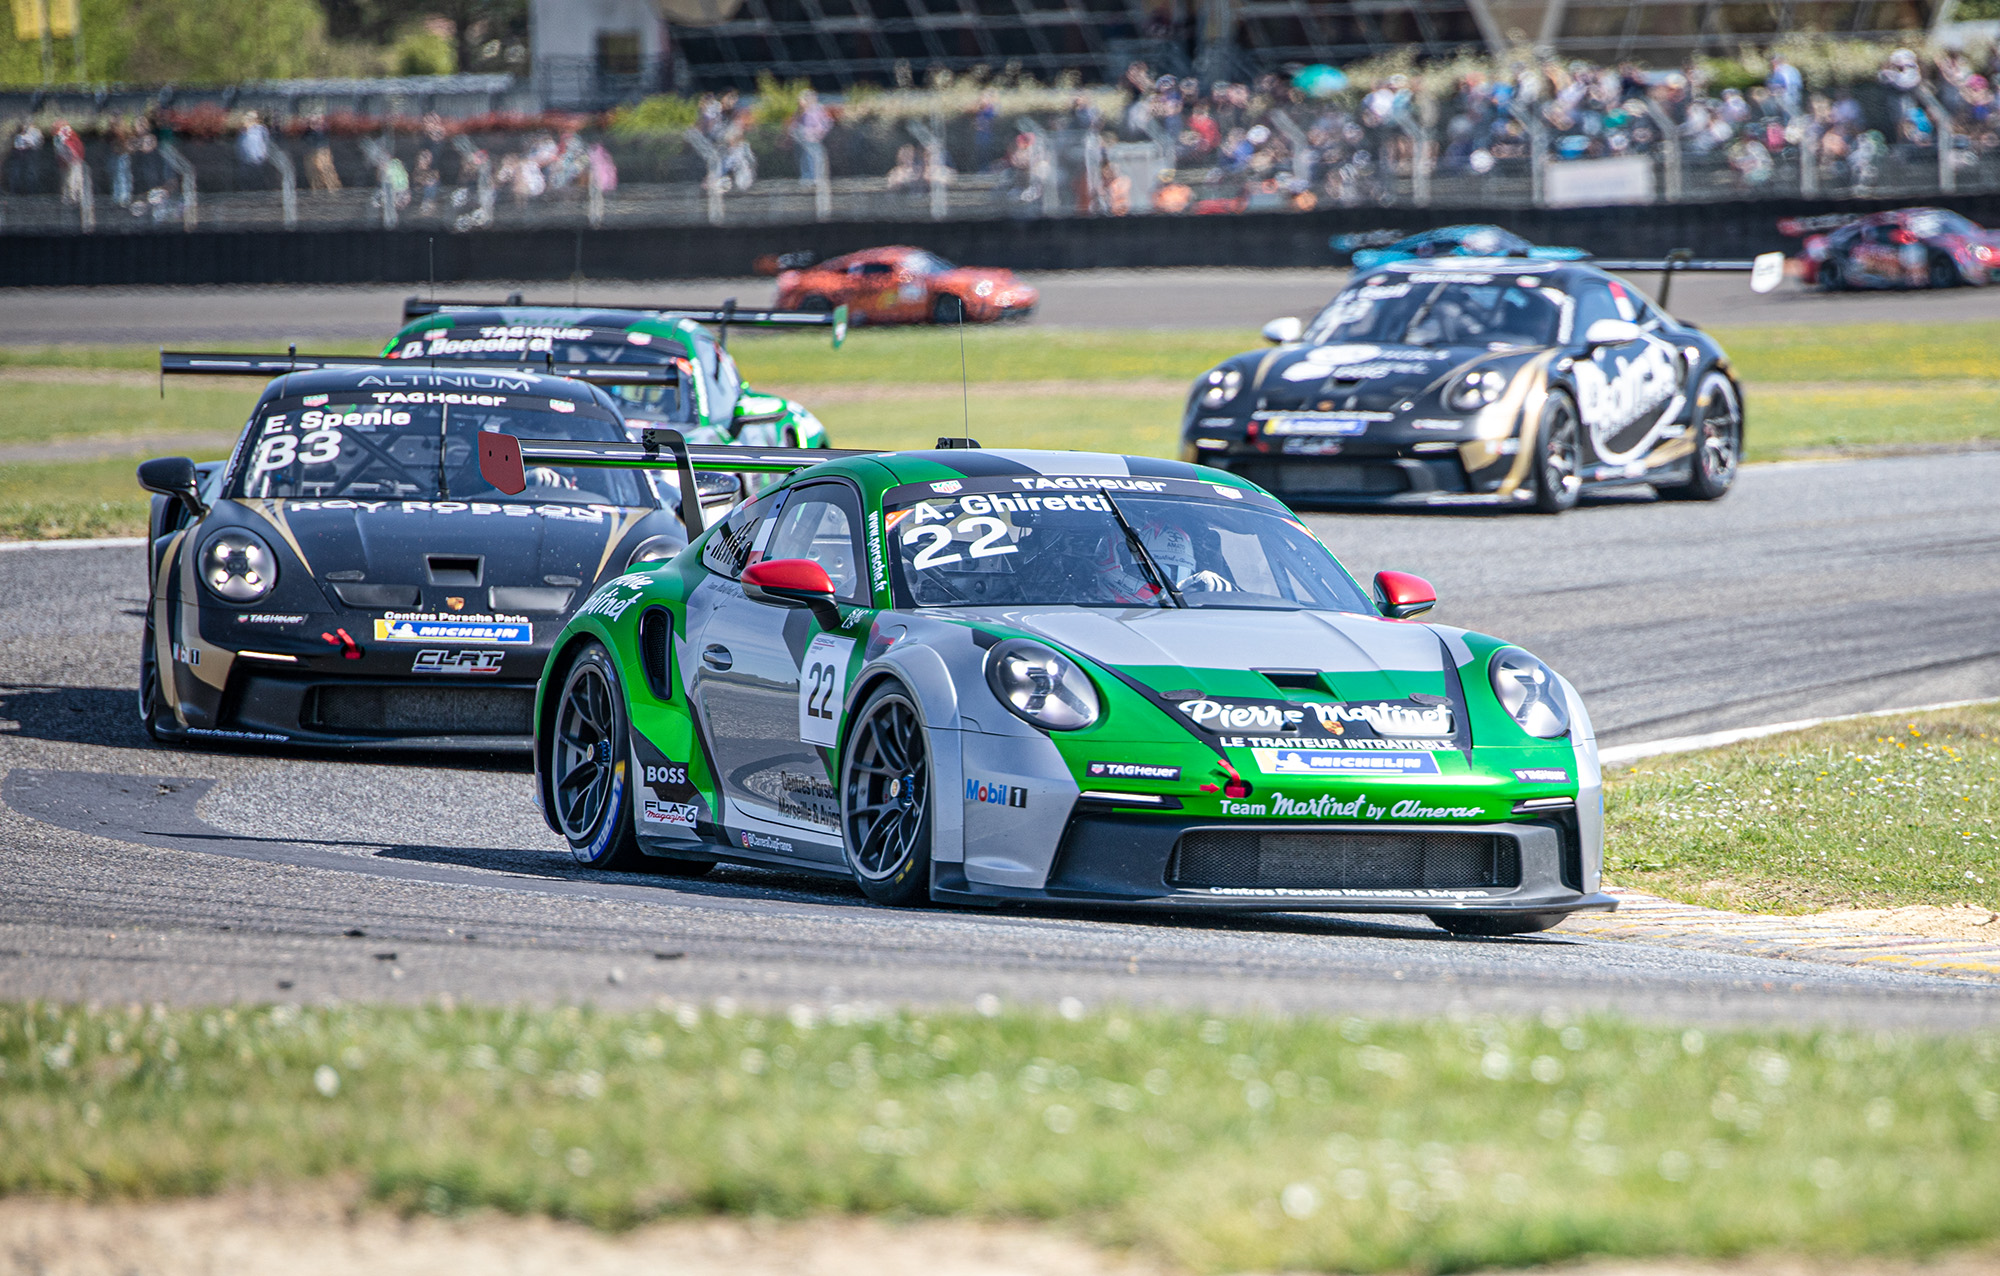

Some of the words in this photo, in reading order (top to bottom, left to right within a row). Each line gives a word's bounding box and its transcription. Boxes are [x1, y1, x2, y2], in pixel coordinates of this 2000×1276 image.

[400, 341, 425, 359] D.
[357, 375, 530, 391] ALTINIUM
[264, 414, 293, 435] E.
[300, 409, 411, 431] Spenle
[291, 500, 387, 513] ROY
[402, 501, 604, 518] ROBSON
[914, 502, 954, 525] A.
[960, 493, 1113, 515] Ghiretti
[867, 510, 888, 592] www.porsche.fr
[903, 516, 1019, 571] 22
[384, 611, 437, 621] Centres
[439, 612, 493, 622] Porsche
[494, 613, 529, 623] Paris
[418, 626, 520, 639] MICHELIN
[415, 651, 504, 667] CLRT
[807, 662, 835, 720] 22
[1179, 700, 1304, 729] Pierre
[1303, 702, 1453, 732] Martinet
[1220, 736, 1245, 748] LE
[1247, 737, 1341, 749] TRAITEUR
[1343, 738, 1457, 751] INTRAITABLE
[1310, 756, 1421, 769] MICHELIN
[646, 766, 686, 784] BOSS
[966, 778, 1007, 806] Mobil
[644, 800, 687, 813] FLAT
[685, 806, 696, 823] 6
[812, 803, 819, 823] &
[1220, 800, 1266, 815] Team
[1271, 792, 1365, 818] Martinet
[1366, 803, 1386, 820] by
[645, 810, 686, 824] magazine
